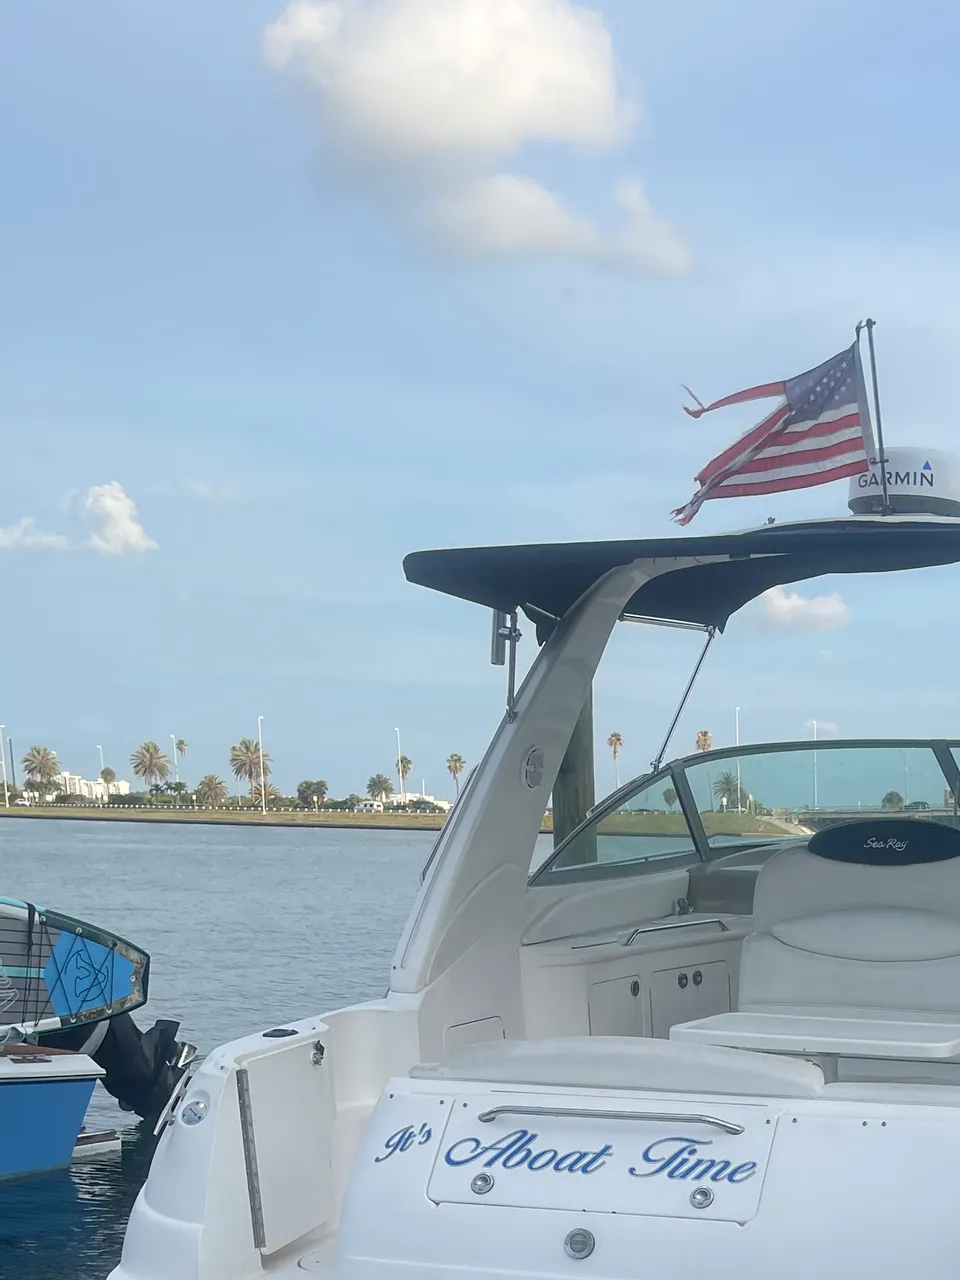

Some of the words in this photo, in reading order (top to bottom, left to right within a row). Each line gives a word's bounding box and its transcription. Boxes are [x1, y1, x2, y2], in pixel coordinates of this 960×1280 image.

[858, 471, 934, 488] GARMIN
[863, 837, 885, 848] Sea
[886, 838, 909, 851] Ray
[374, 1122, 433, 1163] It's
[444, 1129, 614, 1176] Aboat
[628, 1136, 758, 1184] Time
